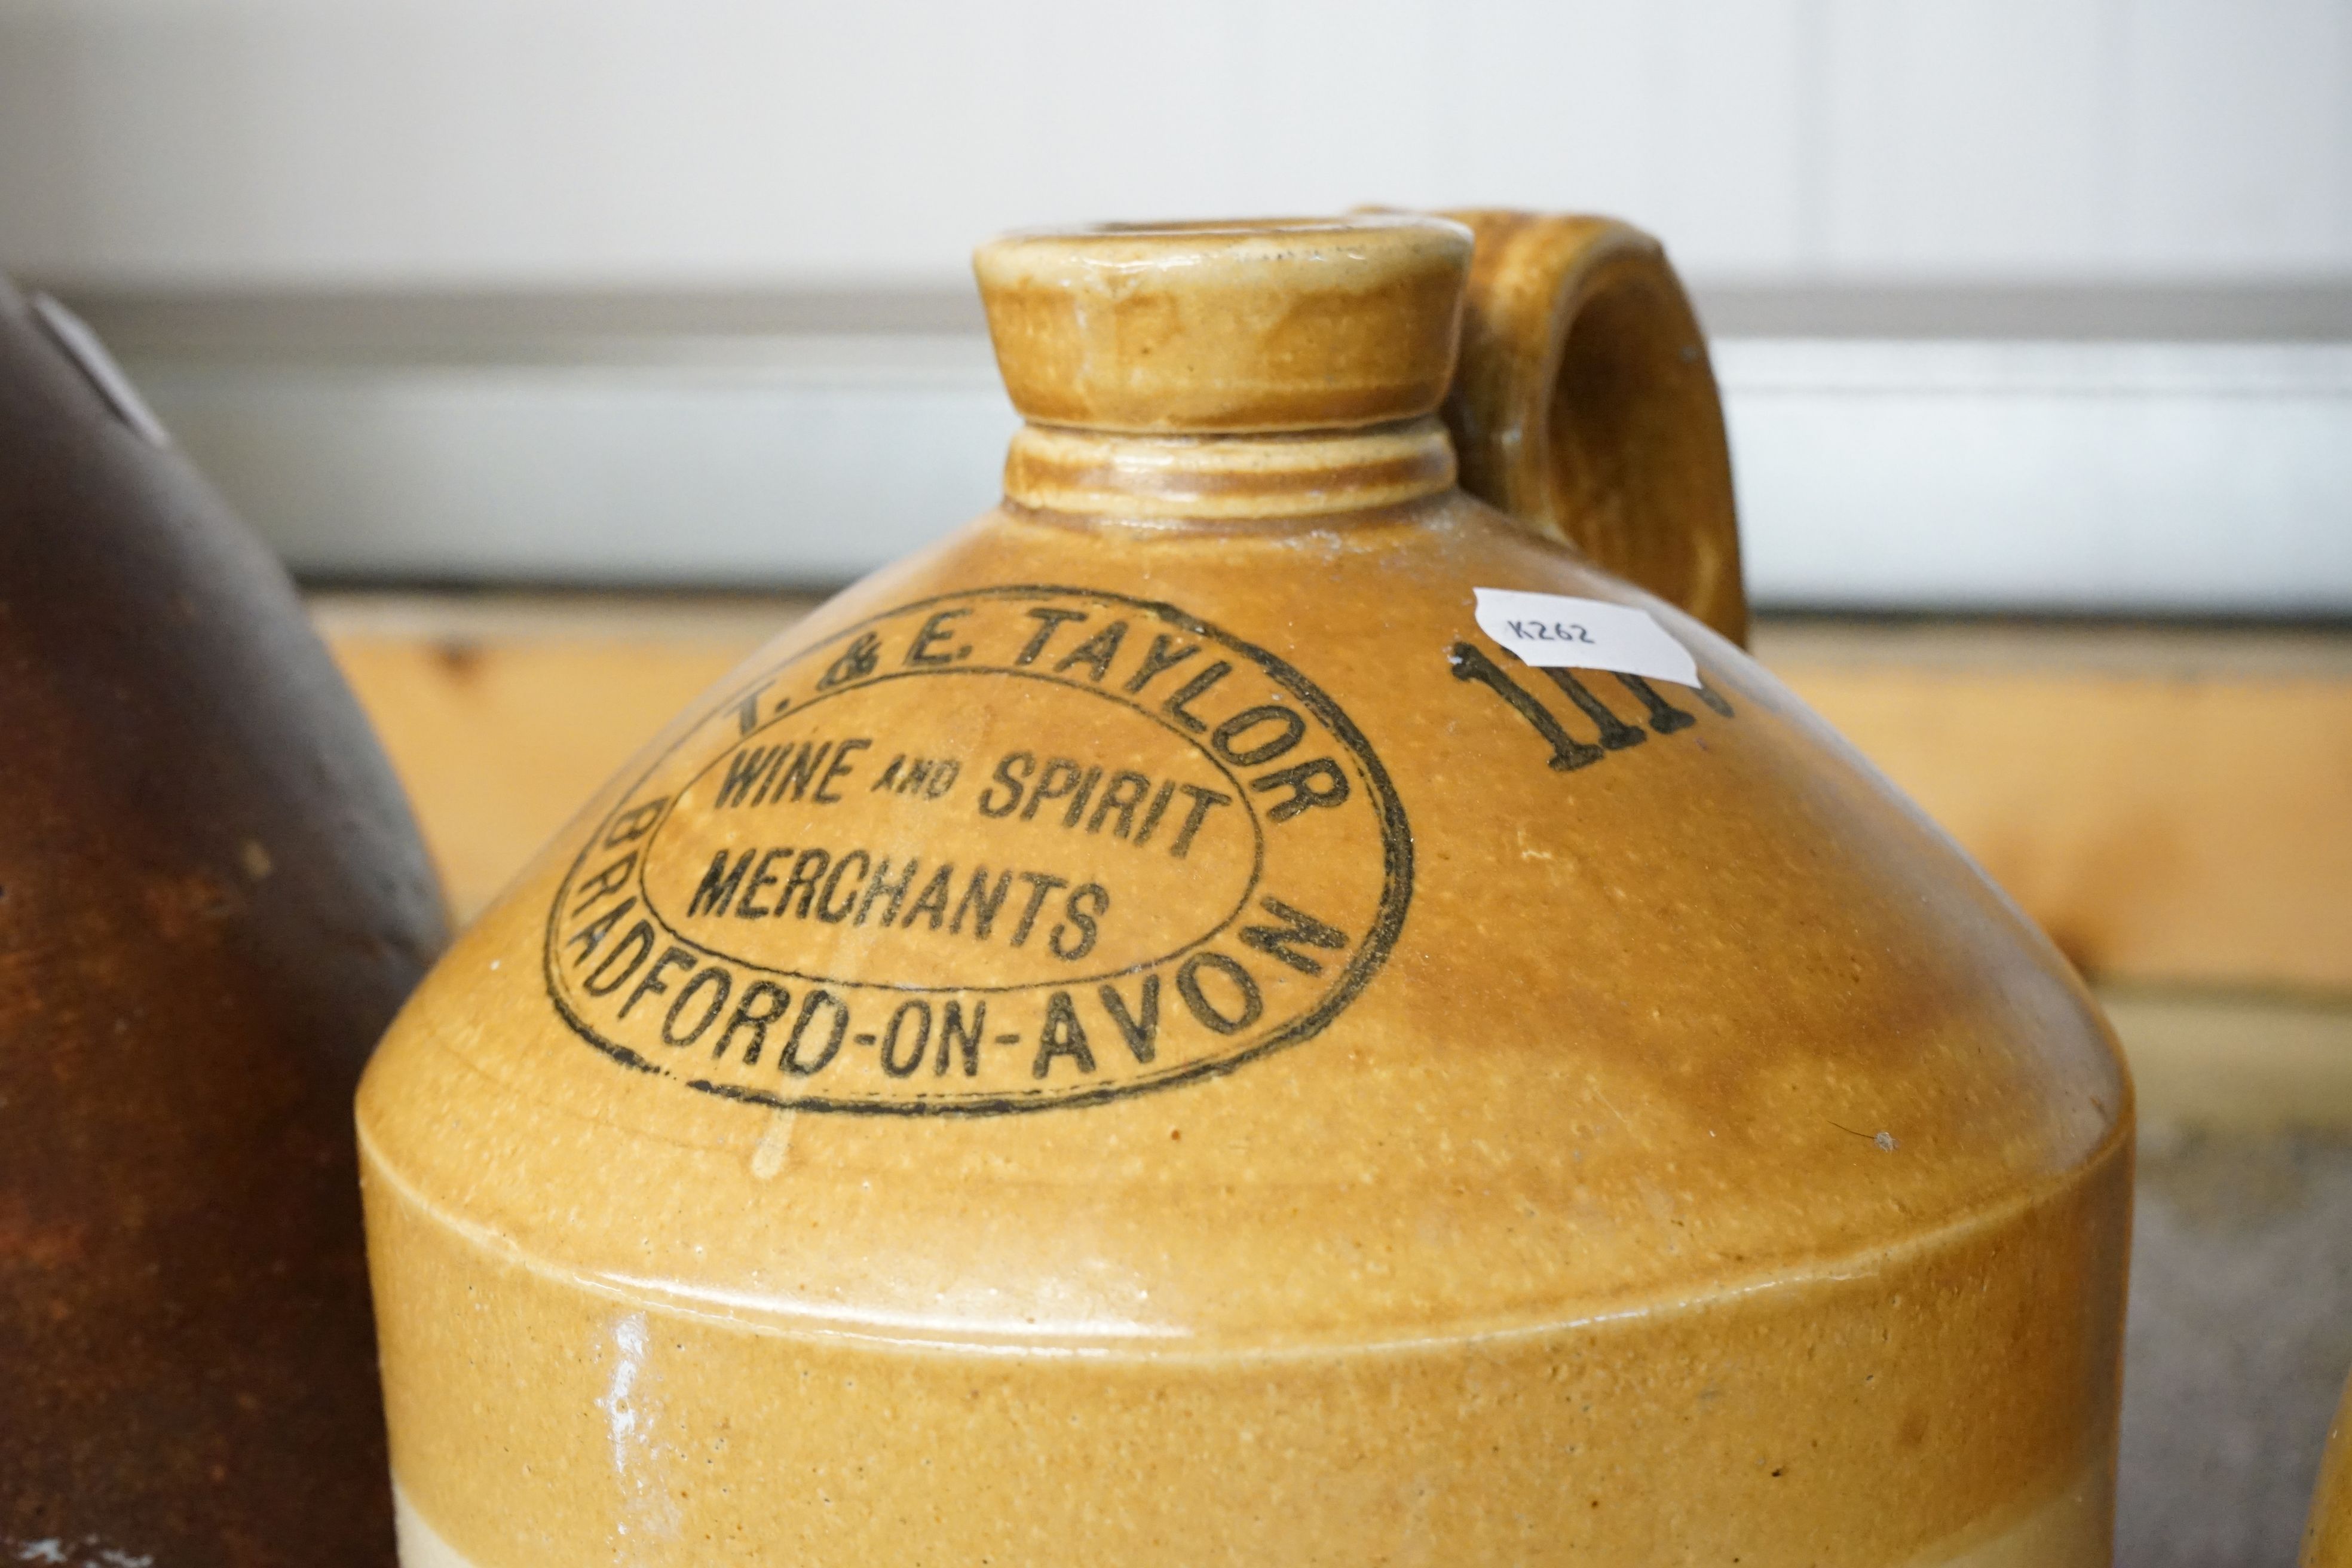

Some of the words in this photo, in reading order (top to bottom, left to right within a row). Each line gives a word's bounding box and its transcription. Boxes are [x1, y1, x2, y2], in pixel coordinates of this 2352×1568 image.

[1507, 620, 1595, 645] K262
[816, 631, 883, 691] &
[904, 608, 974, 666] E.
[1015, 607, 1350, 823] TAYLOR
[714, 739, 872, 808] WINE
[870, 755, 960, 801] AND
[978, 751, 1231, 859] SPIRIT
[567, 795, 1350, 1079] BRADFORD-ON-AVON
[686, 847, 1110, 960] MERCHANTS
